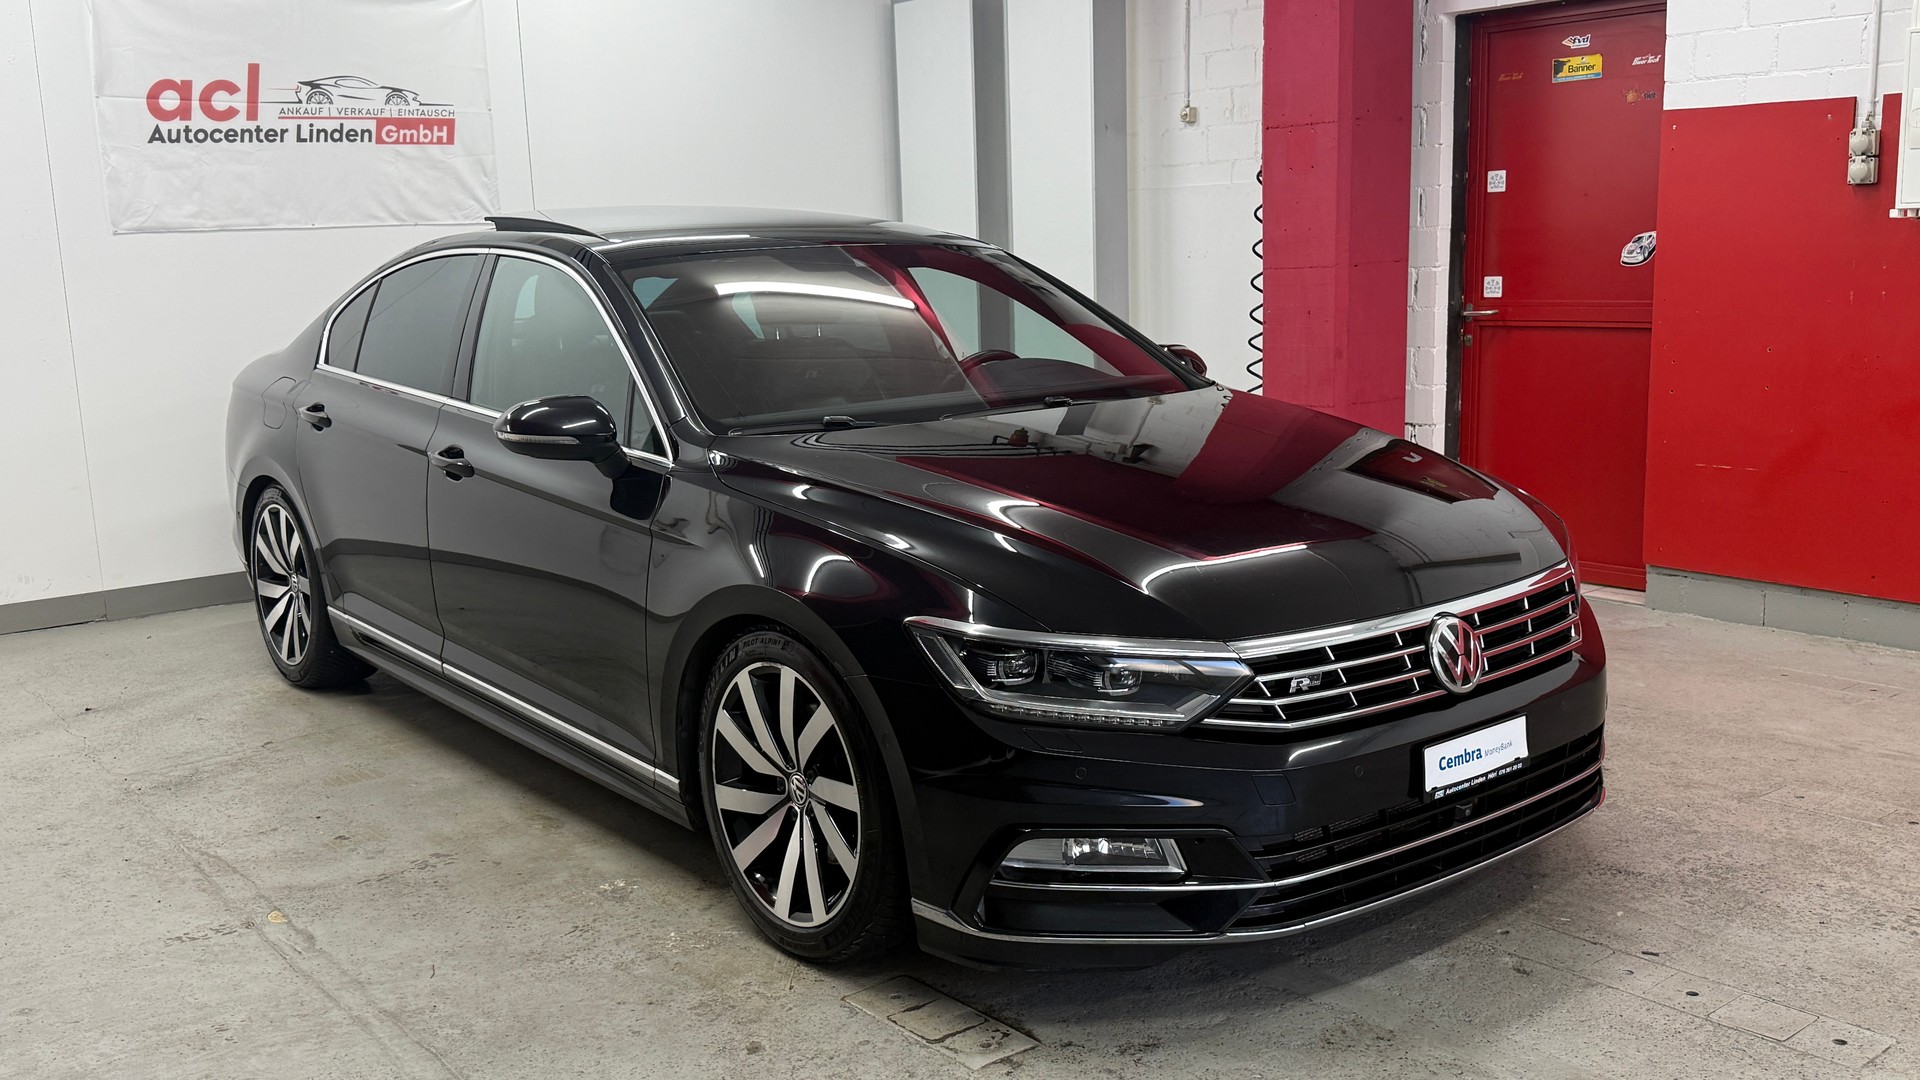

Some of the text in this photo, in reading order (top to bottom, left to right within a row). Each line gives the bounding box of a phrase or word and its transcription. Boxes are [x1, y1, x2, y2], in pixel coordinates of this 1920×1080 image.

[1568, 64, 1596, 73] Banner
[146, 63, 260, 122] acl
[279, 107, 455, 118] ANKAUF VERKAUF EINTAUSCH
[147, 123, 448, 144] Autocenter Linden GmbH
[1439, 739, 1513, 771] Cembra MoneyBank
